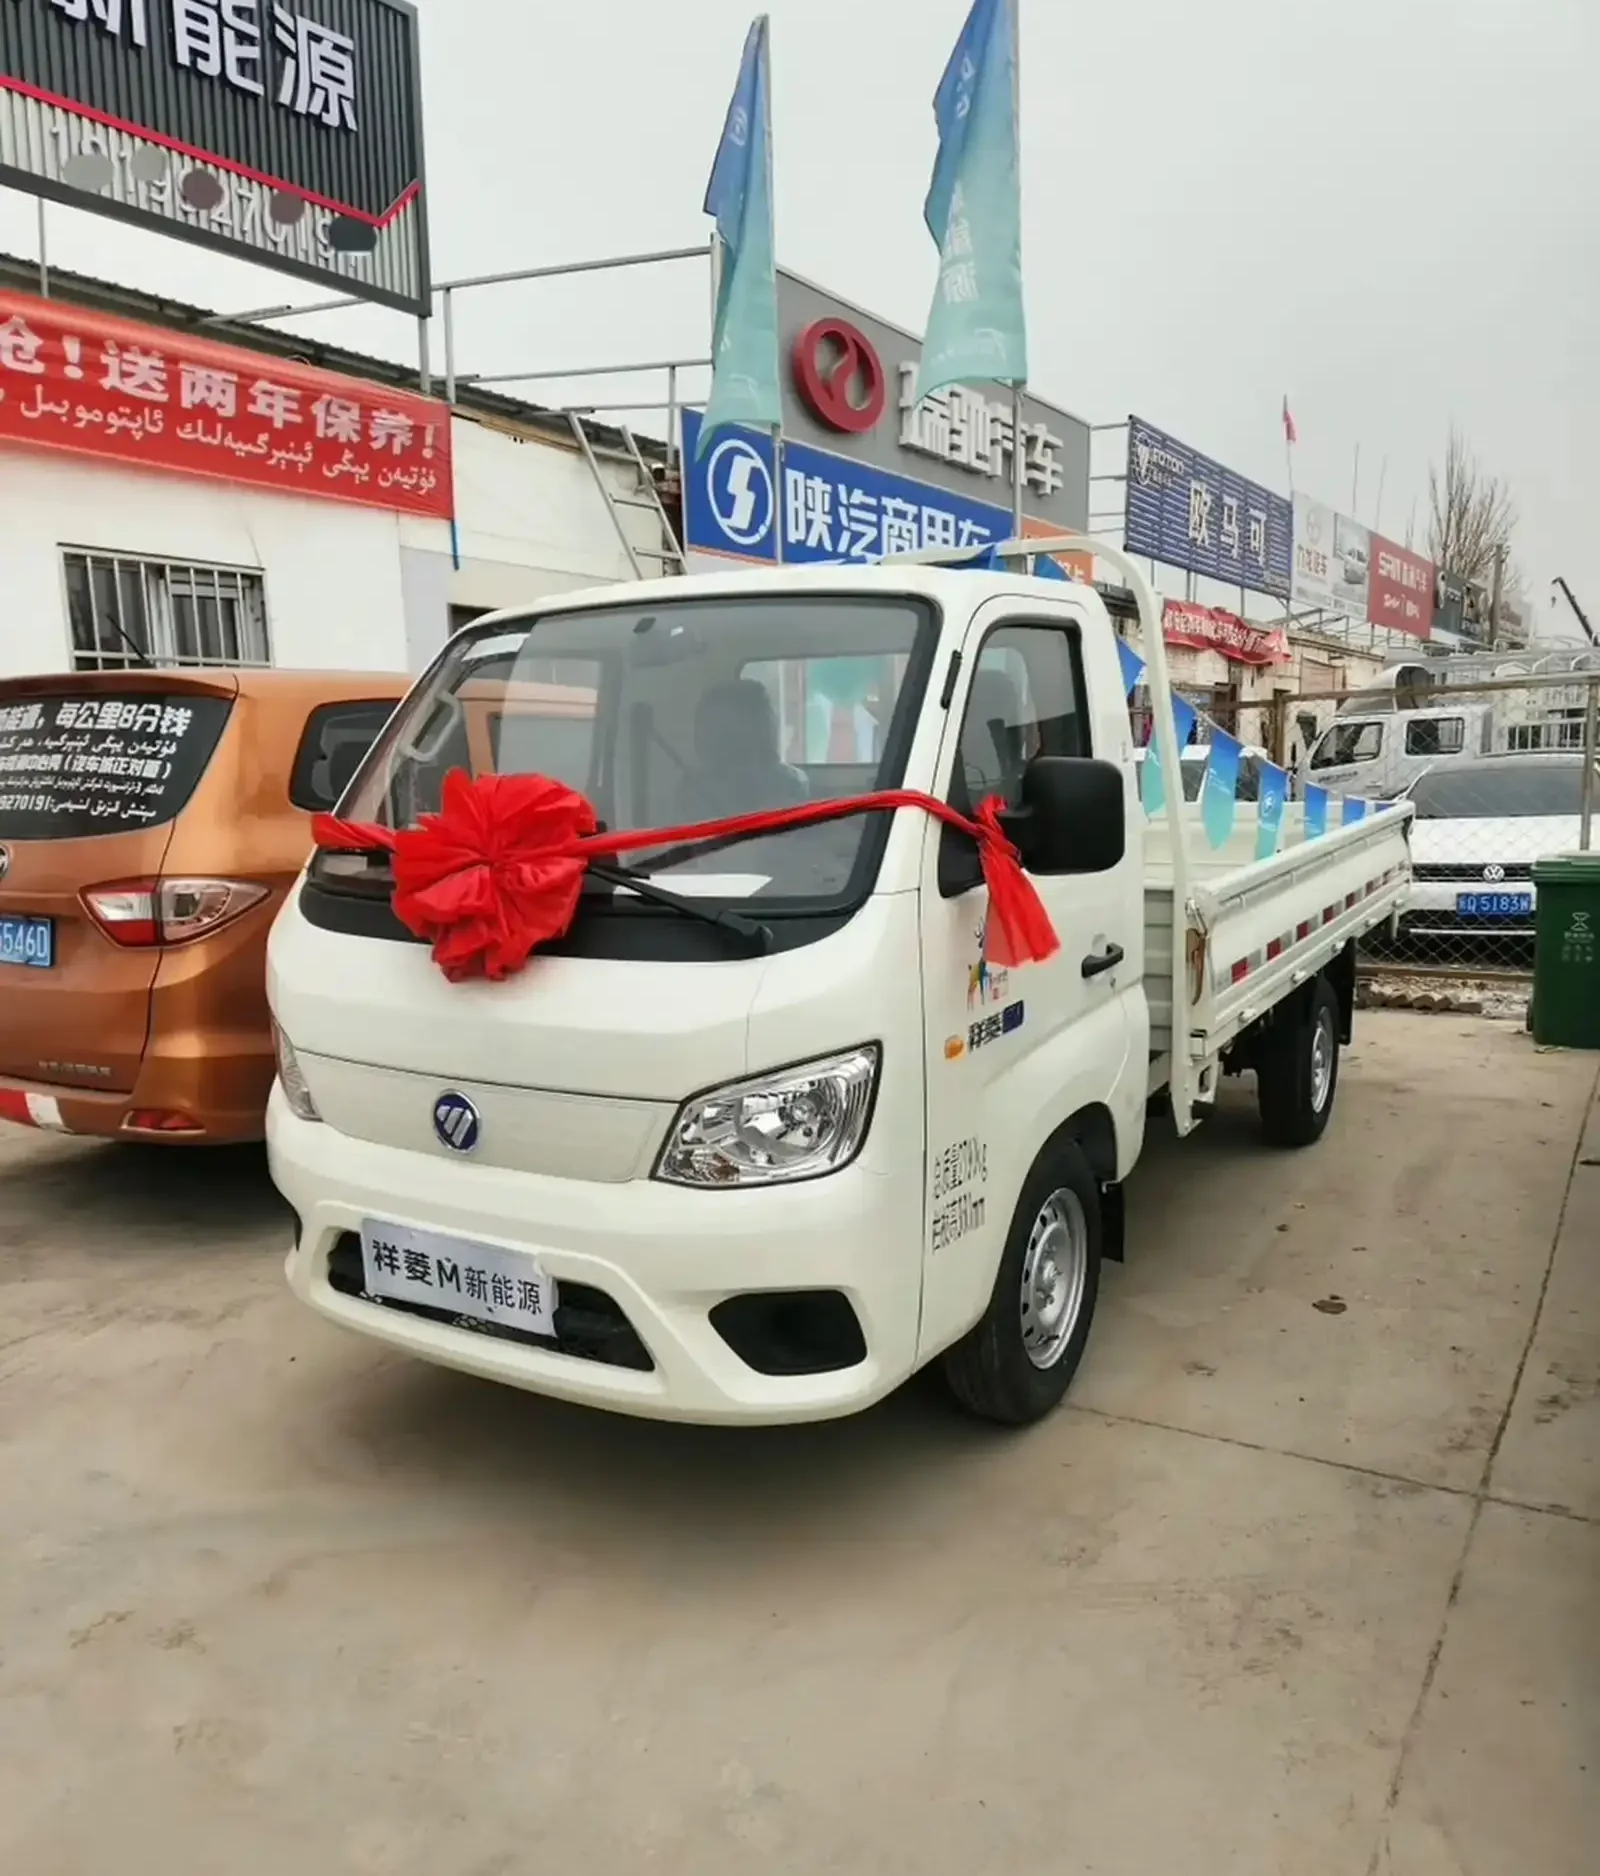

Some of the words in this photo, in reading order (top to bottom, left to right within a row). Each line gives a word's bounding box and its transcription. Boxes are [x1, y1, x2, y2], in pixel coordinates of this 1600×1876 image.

[371, 1238, 543, 1316] 祥菱M新能源
